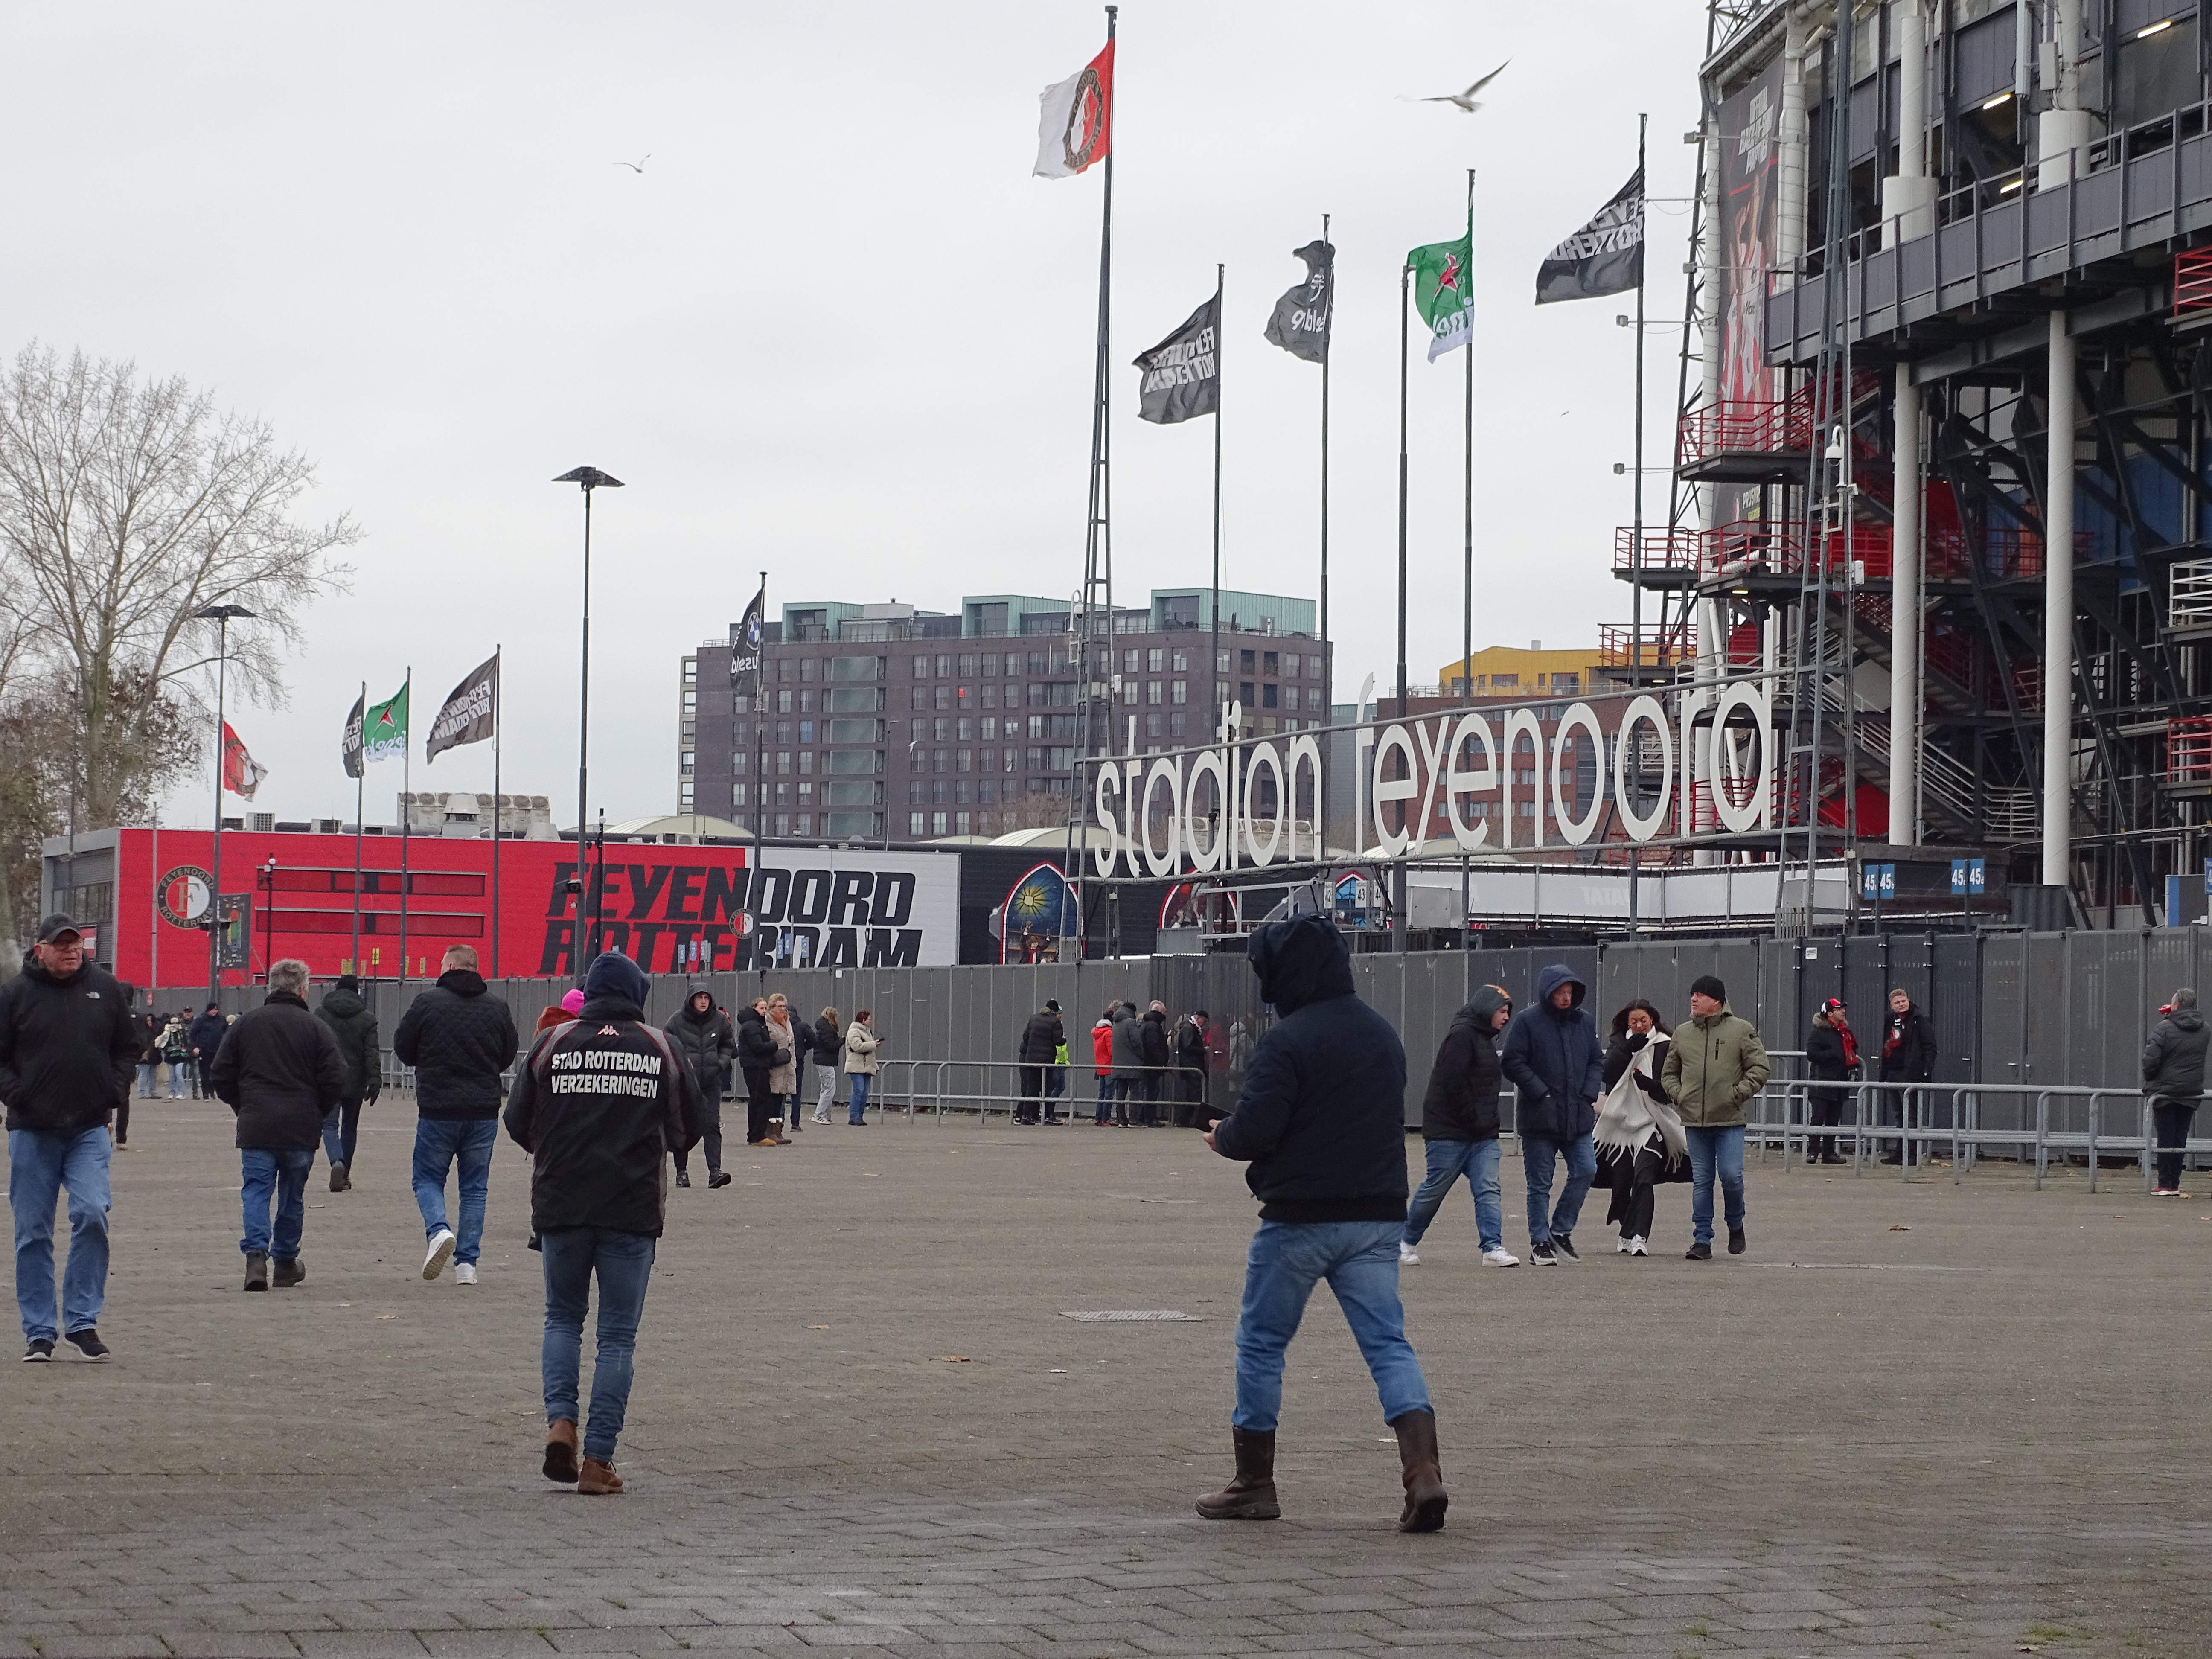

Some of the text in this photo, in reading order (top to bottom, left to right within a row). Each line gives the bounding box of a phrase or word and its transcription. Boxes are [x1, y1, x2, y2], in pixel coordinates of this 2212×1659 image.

[1094, 620, 1772, 878] stadion feyenoord
[175, 882, 200, 912] F
[545, 862, 916, 927] FEYENOORD
[1357, 888, 1365, 901] 43
[551, 1050, 661, 1075] STAD ROTTERDAM
[551, 1074, 658, 1099] VERZEKERINGEN
